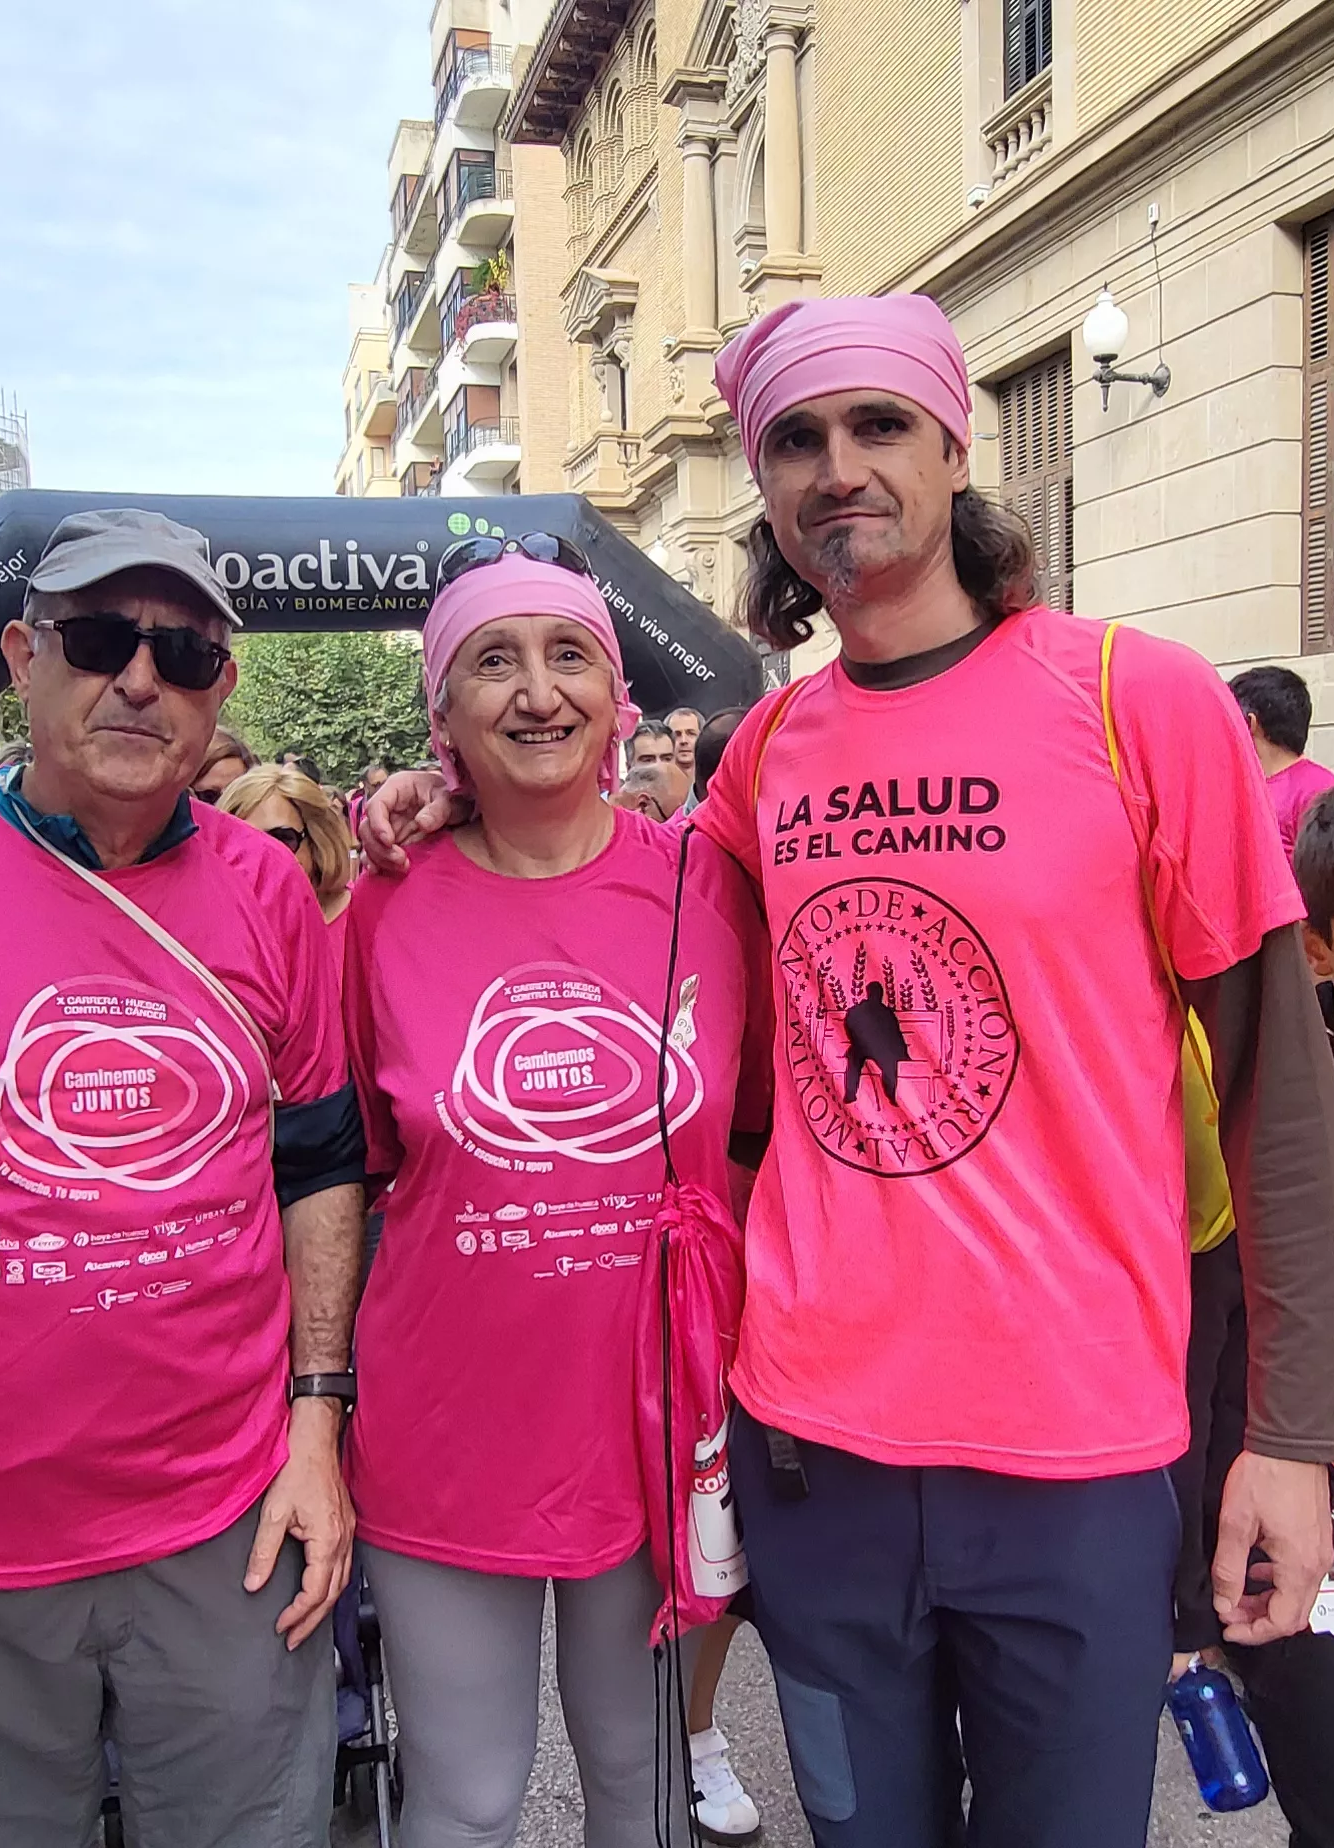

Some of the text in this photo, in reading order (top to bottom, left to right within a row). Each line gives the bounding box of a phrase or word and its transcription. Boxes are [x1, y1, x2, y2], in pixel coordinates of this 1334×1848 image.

[204, 538, 430, 590] oactiva
[226, 594, 430, 611] GÍA Y BIOMECÁNICA
[600, 581, 716, 682] bien, vive mejor
[775, 776, 1001, 836] LA SALUD
[774, 824, 1007, 867] ES EL CAMINO
[855, 888, 905, 922] DE
[67, 996, 118, 1006] CARRERA
[125, 998, 166, 1012] HUESCA
[514, 1047, 595, 1073] Caminemos
[64, 1066, 157, 1090] Caminemos
[522, 1065, 594, 1091] JUNTOS
[71, 1086, 151, 1113] JUNTOS
[866, 1093, 986, 1169] RURAL
